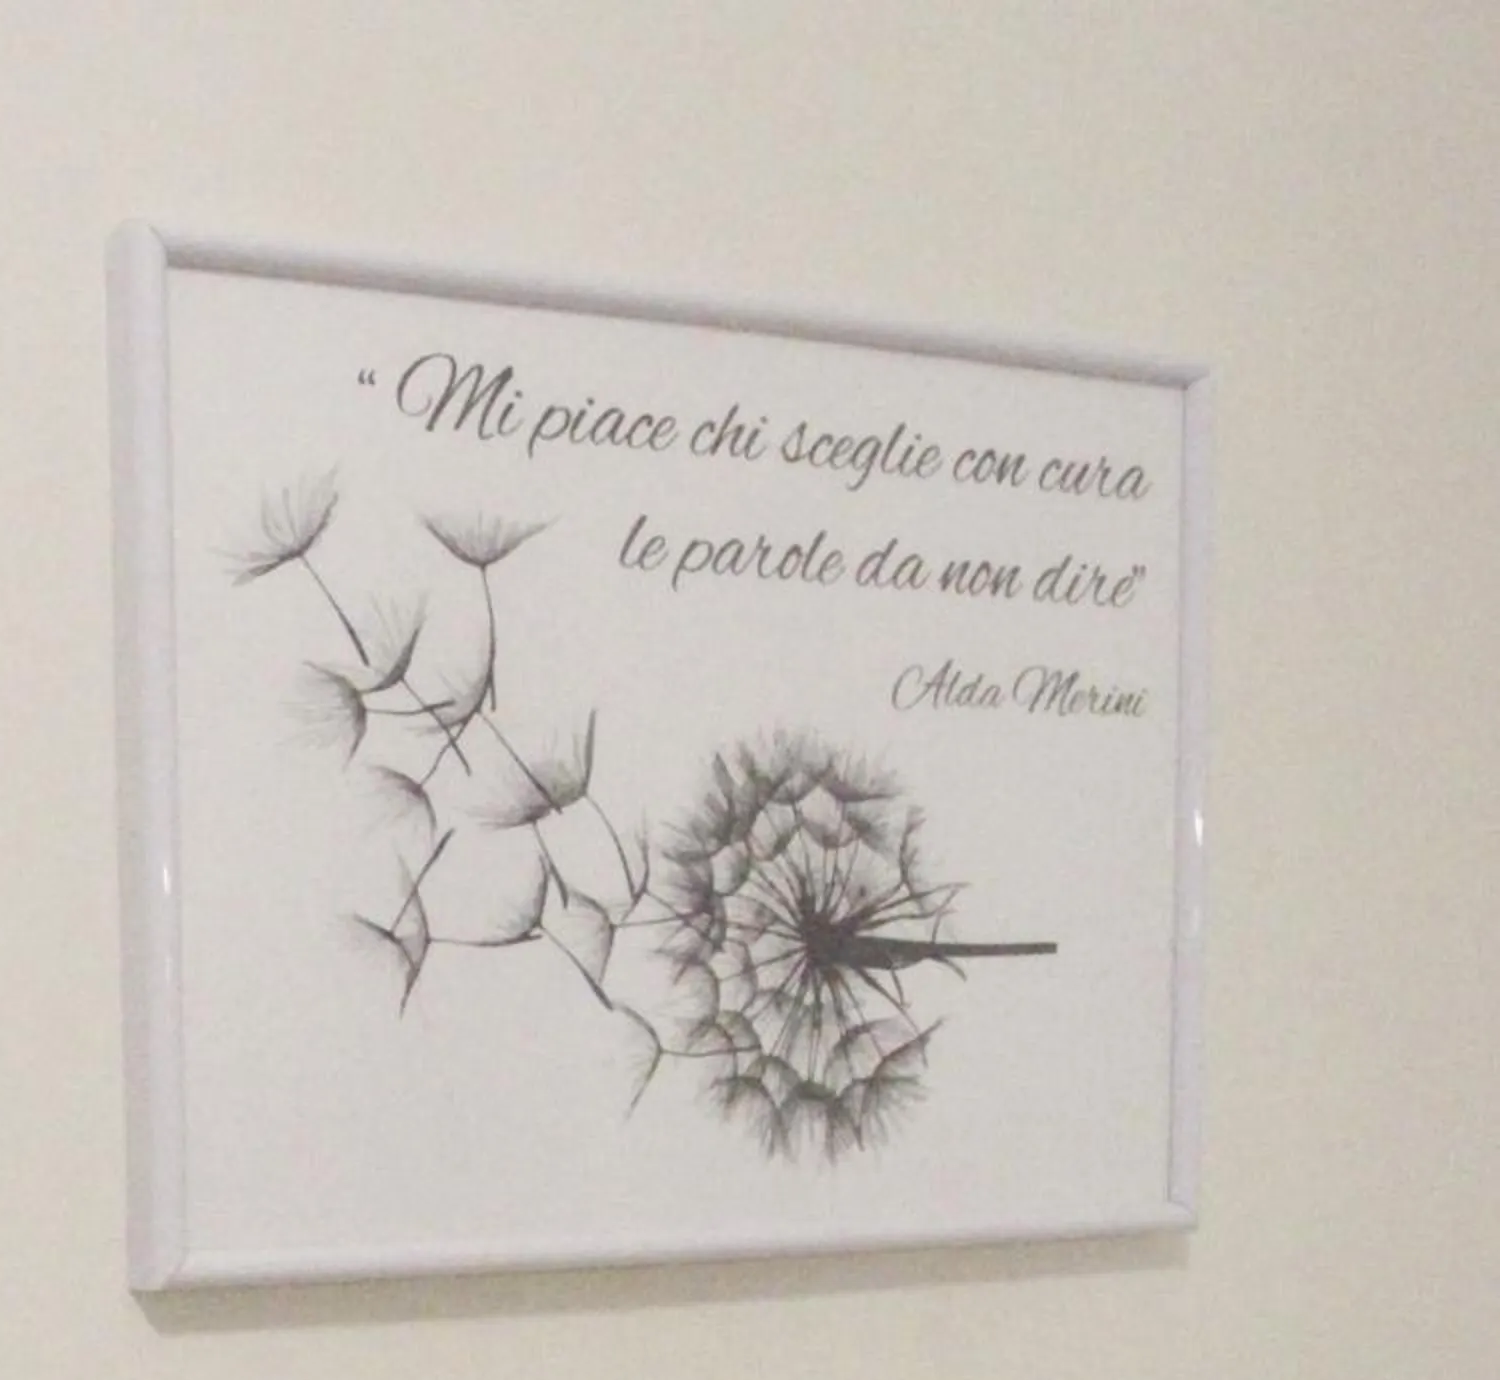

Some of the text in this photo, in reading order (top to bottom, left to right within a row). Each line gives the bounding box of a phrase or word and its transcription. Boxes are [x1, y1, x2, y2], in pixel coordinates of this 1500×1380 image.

[527, 396, 680, 460] piace
[689, 402, 768, 462] chi
[780, 420, 942, 492] sceglie
[952, 447, 1029, 488] con
[1038, 454, 1152, 501] cura
[618, 513, 669, 571] le
[670, 529, 847, 592] parole
[854, 537, 932, 590] da
[937, 560, 1025, 599] non
[891, 658, 1150, 718] Alda Merini
